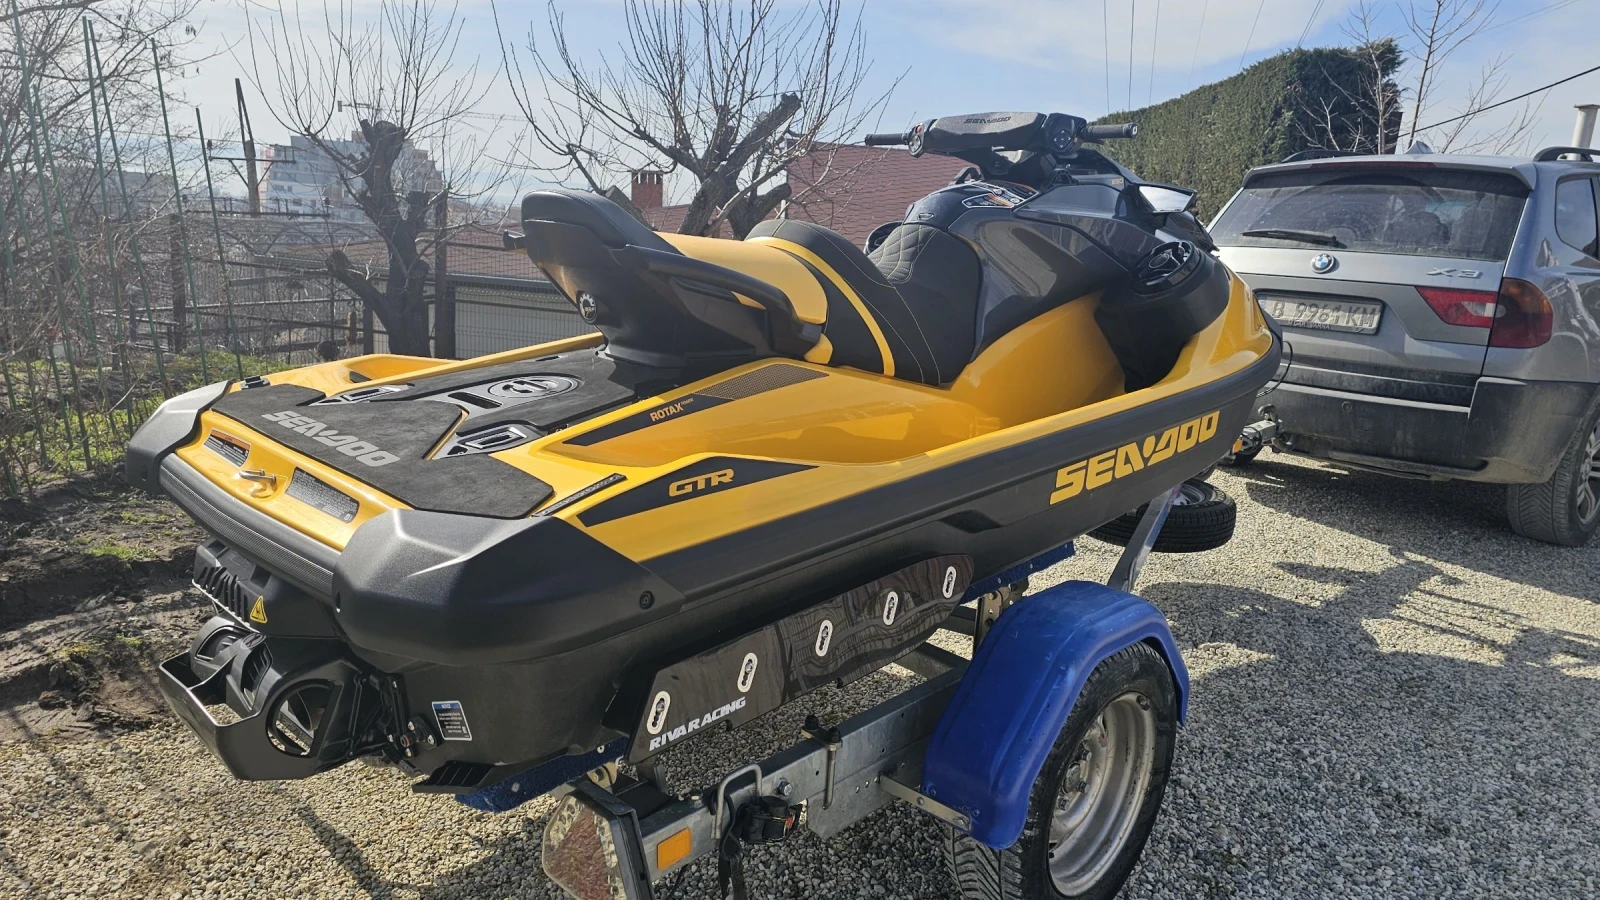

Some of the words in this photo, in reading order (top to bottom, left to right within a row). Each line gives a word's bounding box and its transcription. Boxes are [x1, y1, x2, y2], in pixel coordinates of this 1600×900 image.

[1424, 266, 1480, 279] X3
[1271, 300, 1285, 318] B
[1345, 306, 1377, 328] KM
[649, 402, 684, 422] ROTAX
[668, 468, 735, 497] GTR
[649, 724, 687, 752] RIVA
[687, 696, 747, 734] RACING
